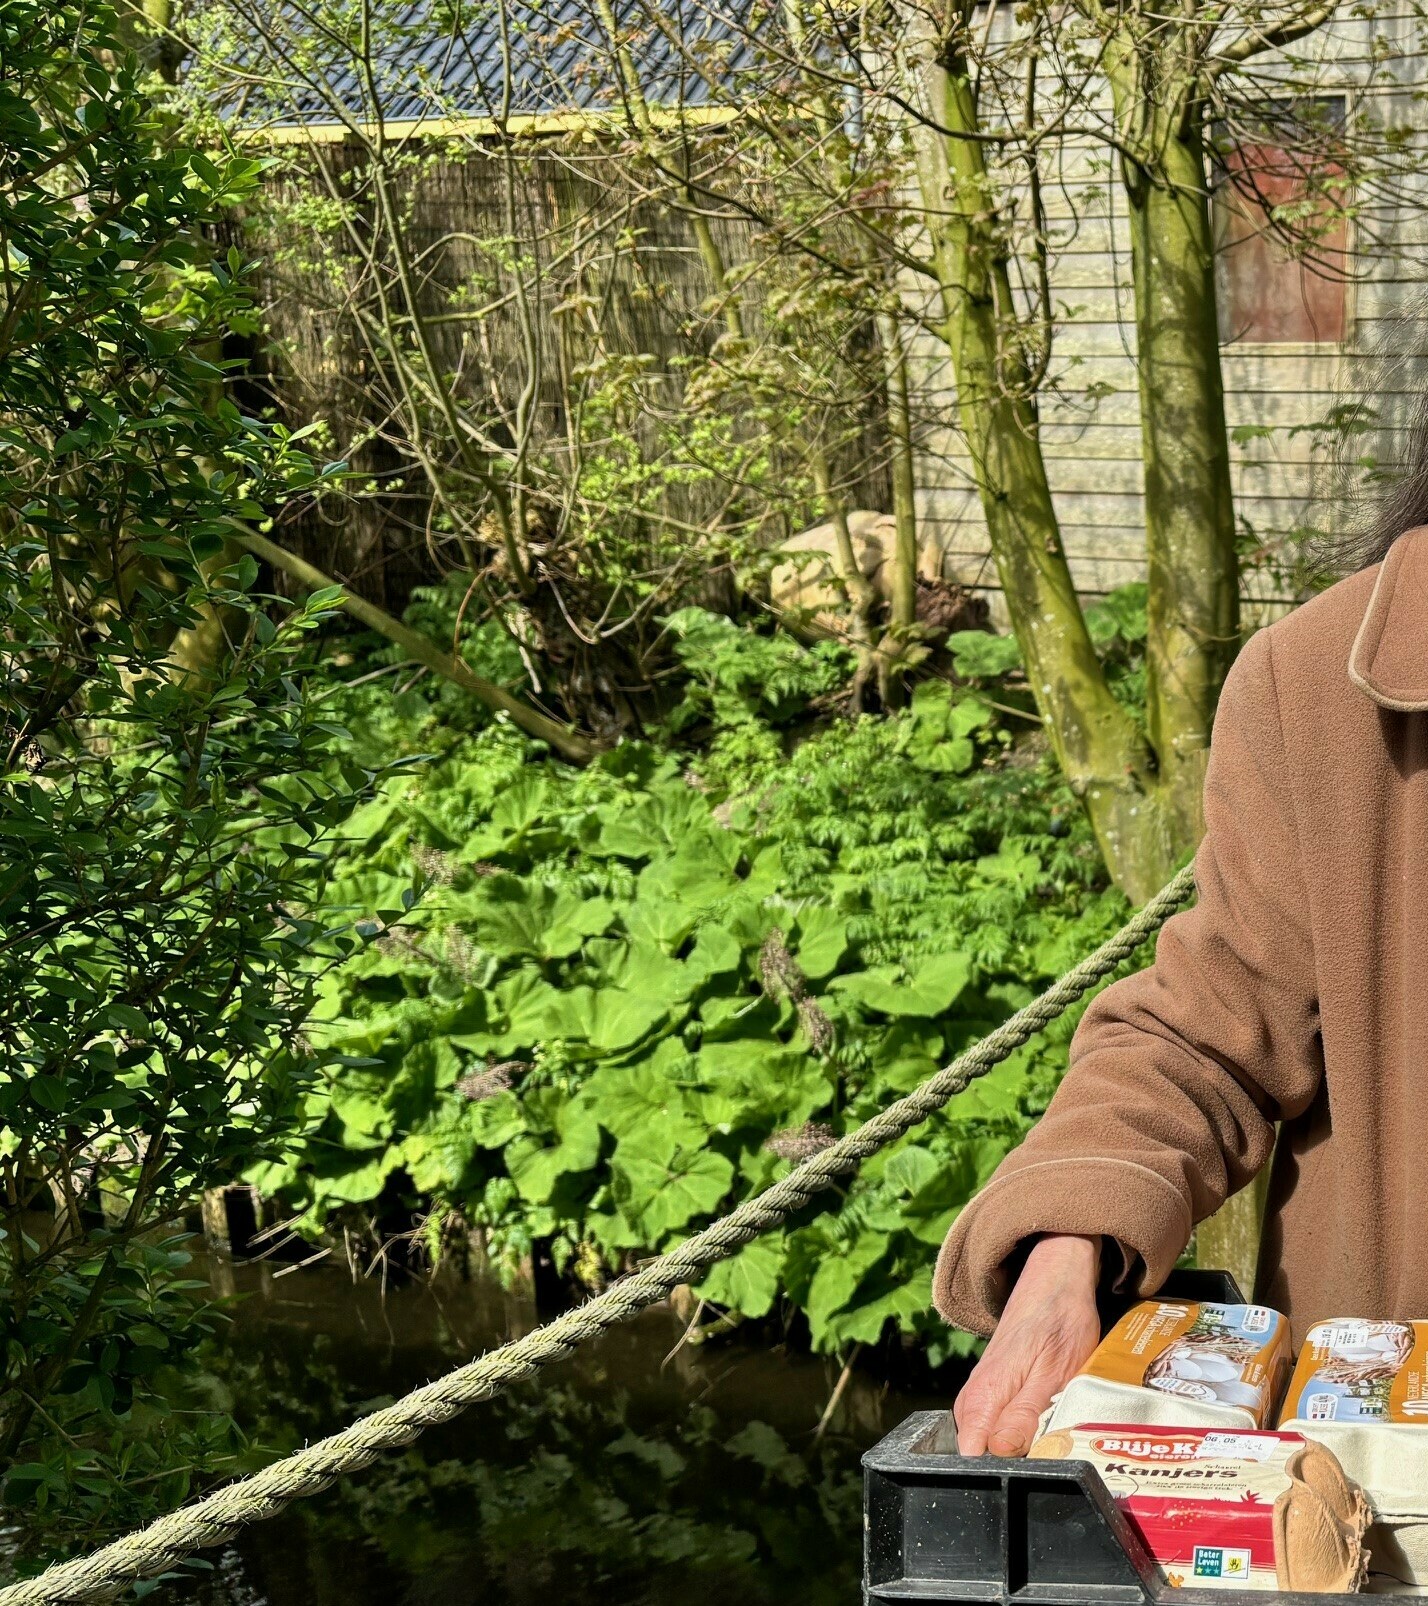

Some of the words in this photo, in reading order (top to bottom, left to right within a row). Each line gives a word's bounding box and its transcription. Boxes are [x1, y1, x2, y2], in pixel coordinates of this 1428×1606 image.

[1156, 1303, 1189, 1318] 10
[1101, 1440, 1170, 1457] Blije
[1105, 1463, 1238, 1480] Kanjers
[1198, 1550, 1220, 1559] Beter
[1197, 1558, 1219, 1567] Leven
